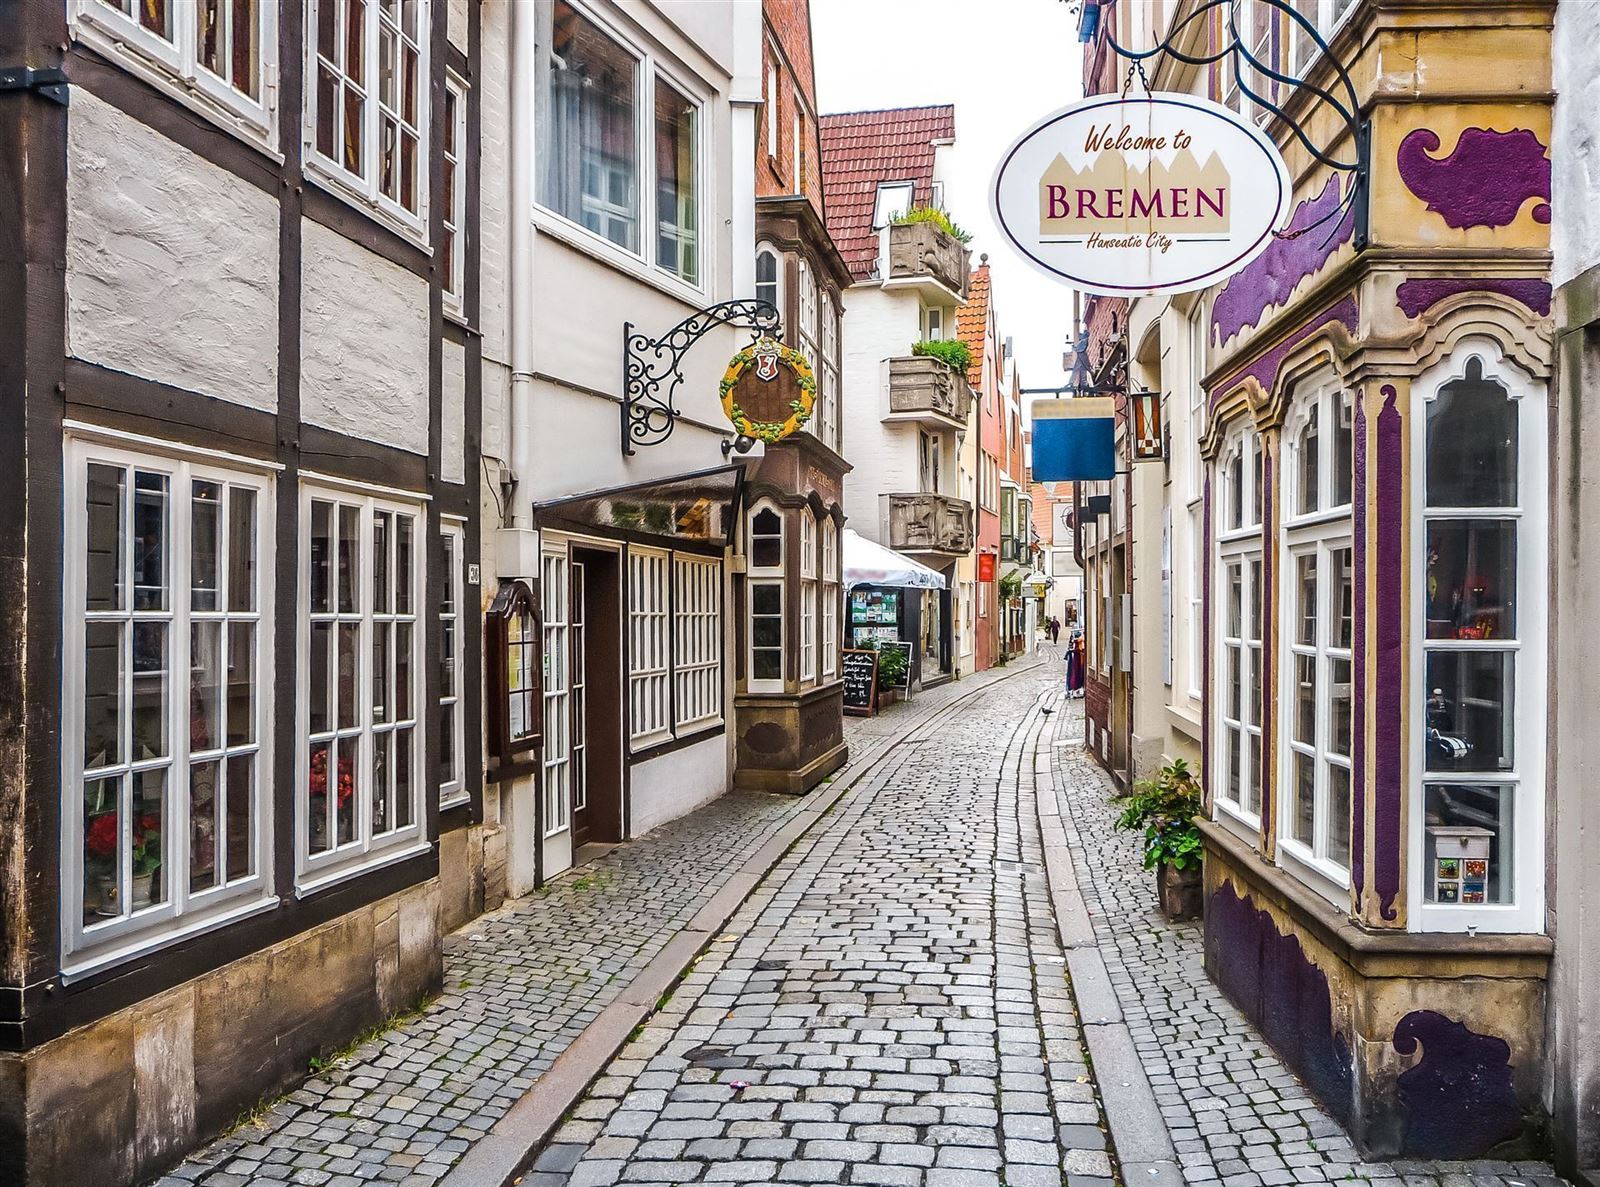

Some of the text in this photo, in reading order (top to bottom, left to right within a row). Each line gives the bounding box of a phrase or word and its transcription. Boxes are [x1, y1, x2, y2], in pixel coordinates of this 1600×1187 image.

[1084, 124, 1192, 153] Welcome to
[1046, 184, 1226, 220] BREMEN
[1086, 231, 1173, 254] Hanseatic City
